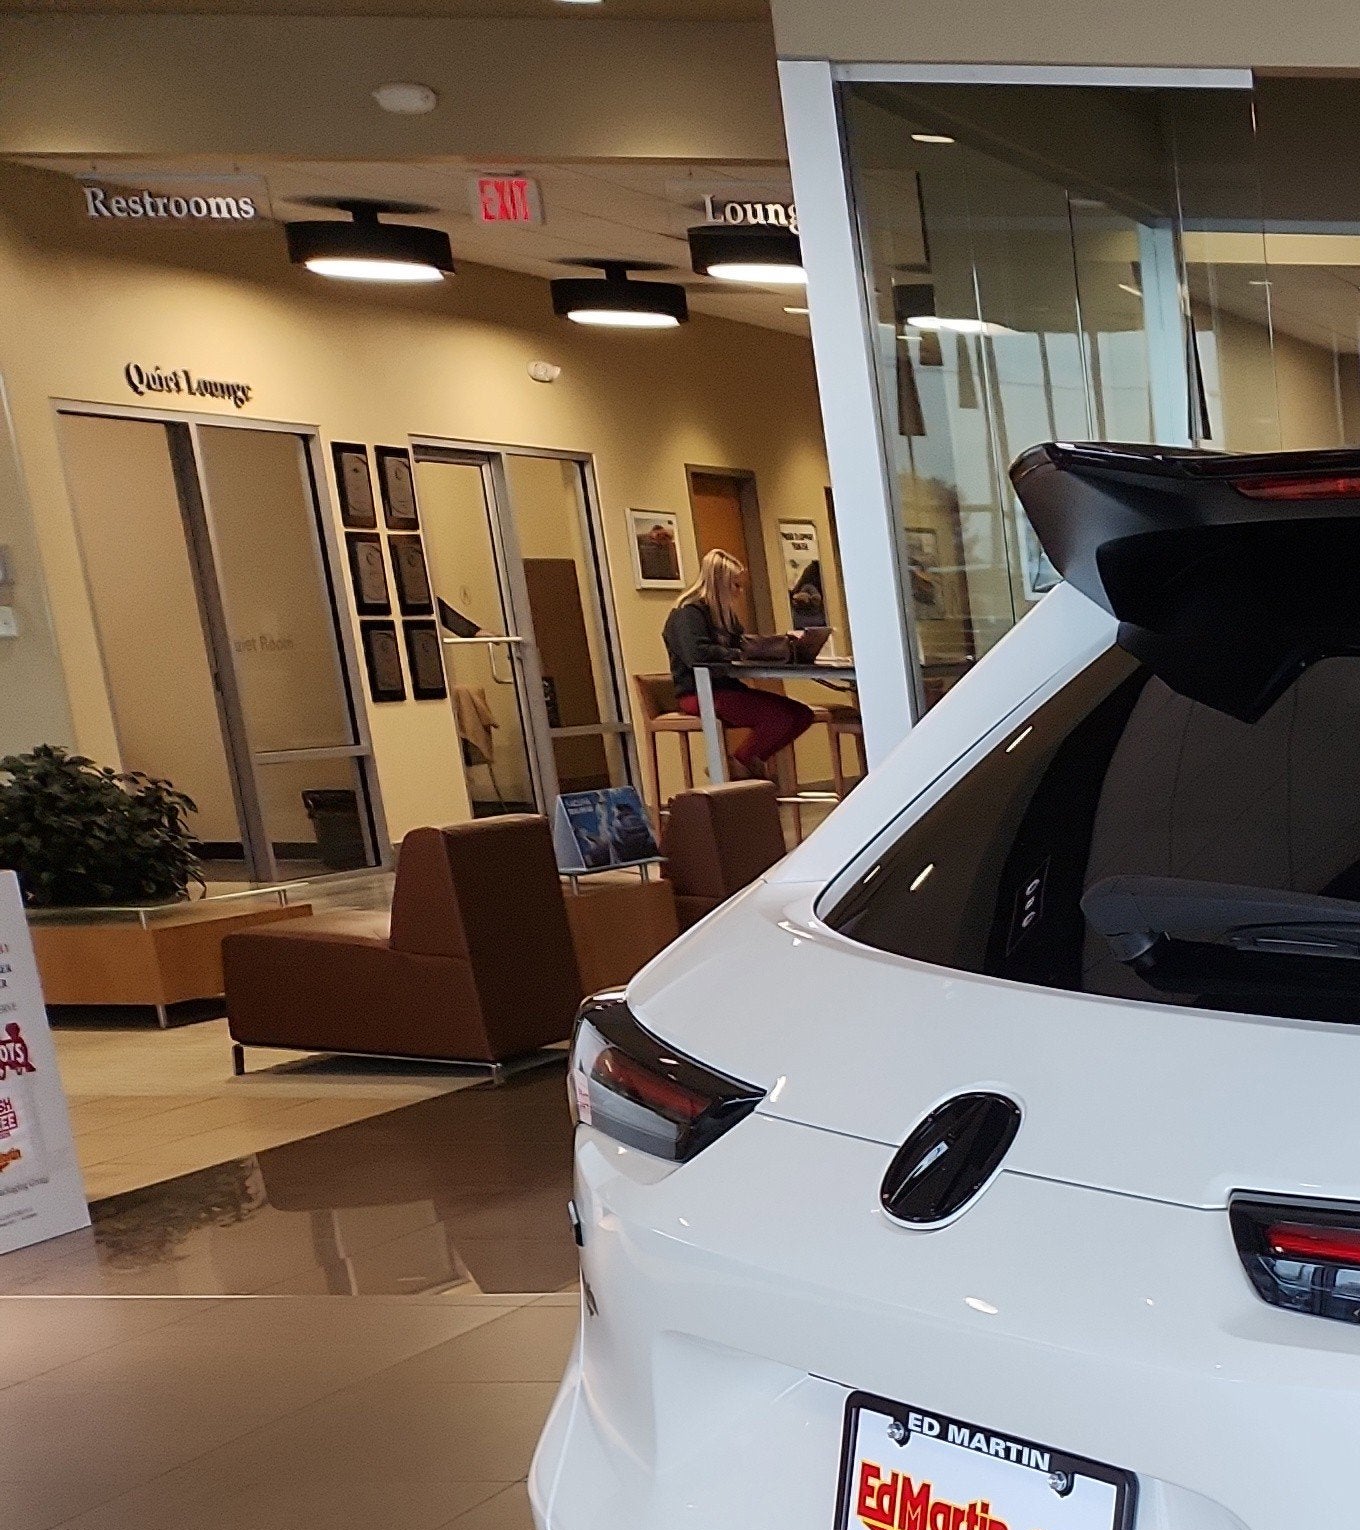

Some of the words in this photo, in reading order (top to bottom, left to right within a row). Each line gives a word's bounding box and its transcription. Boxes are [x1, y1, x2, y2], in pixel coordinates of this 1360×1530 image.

[83, 186, 256, 218] Restrooms
[479, 179, 529, 220] EXIT
[701, 194, 800, 235] Loung
[124, 362, 182, 396] Quiet
[182, 369, 252, 409] Lounge
[908, 1411, 940, 1437] ED
[947, 1423, 1051, 1473] MARTIN
